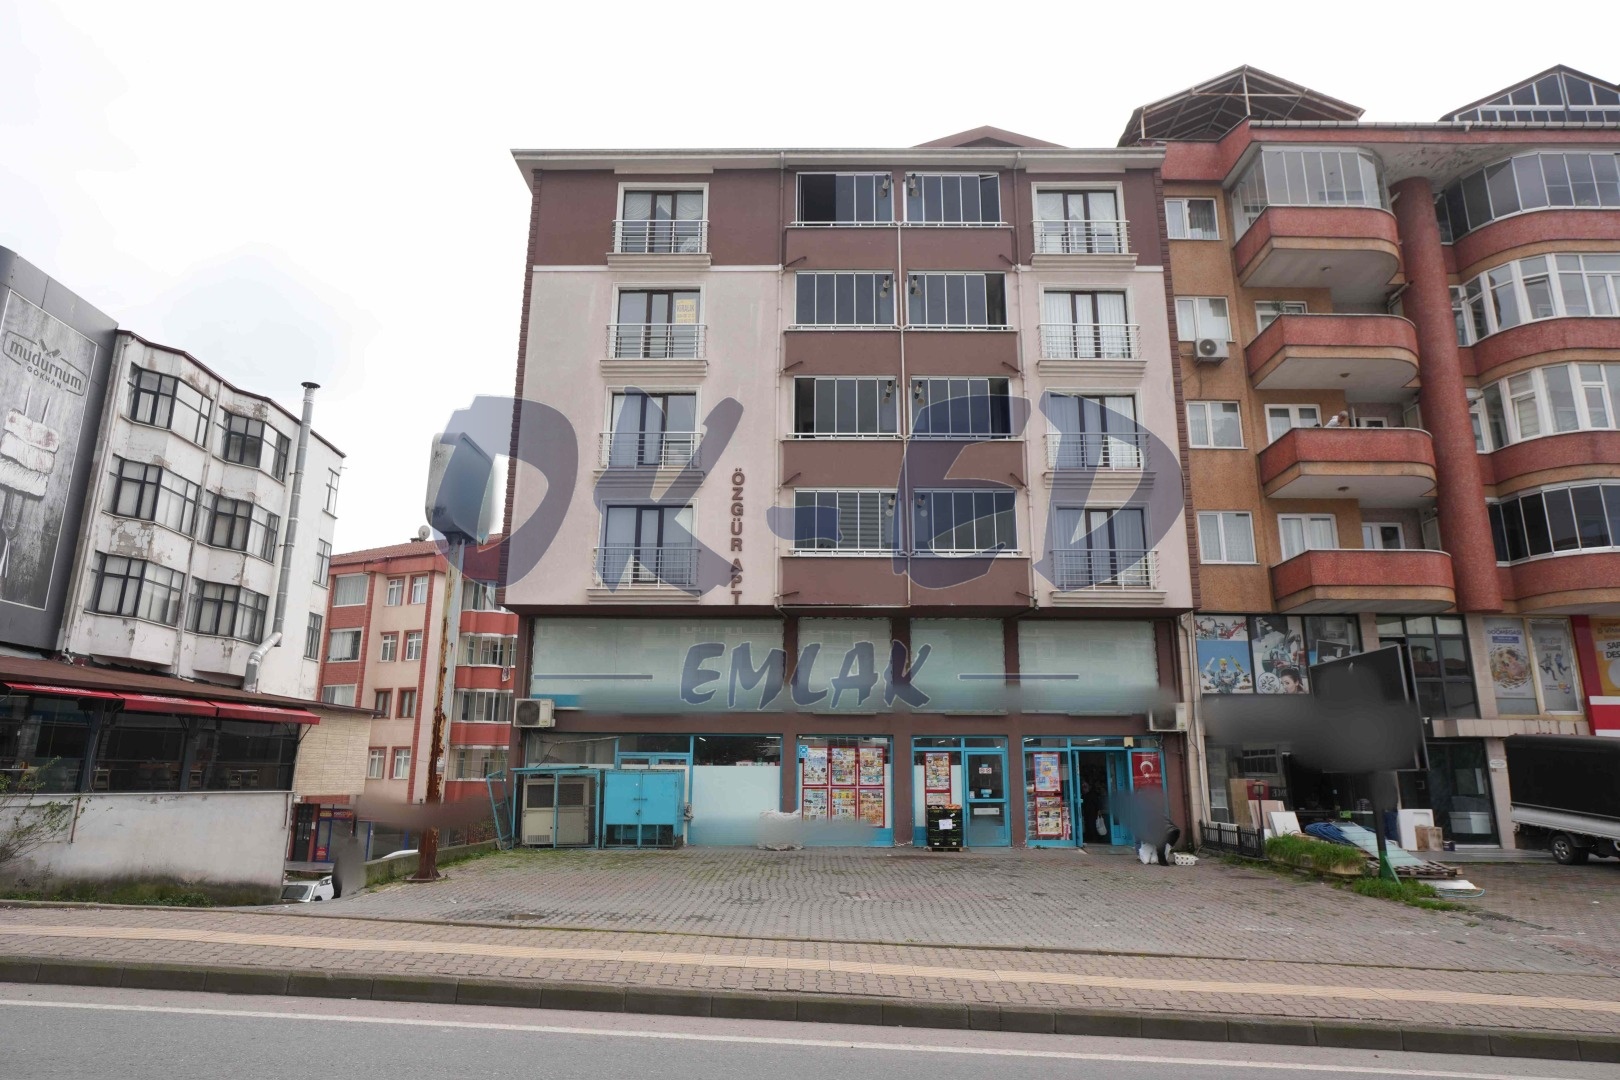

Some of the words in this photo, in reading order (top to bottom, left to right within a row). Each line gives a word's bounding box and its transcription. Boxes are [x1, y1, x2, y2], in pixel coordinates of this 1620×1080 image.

[9, 340, 82, 390] mudurnum
[26, 365, 62, 389] GÖKHAN
[730, 467, 746, 552] ÖZGÜR
[730, 558, 744, 605] APT
